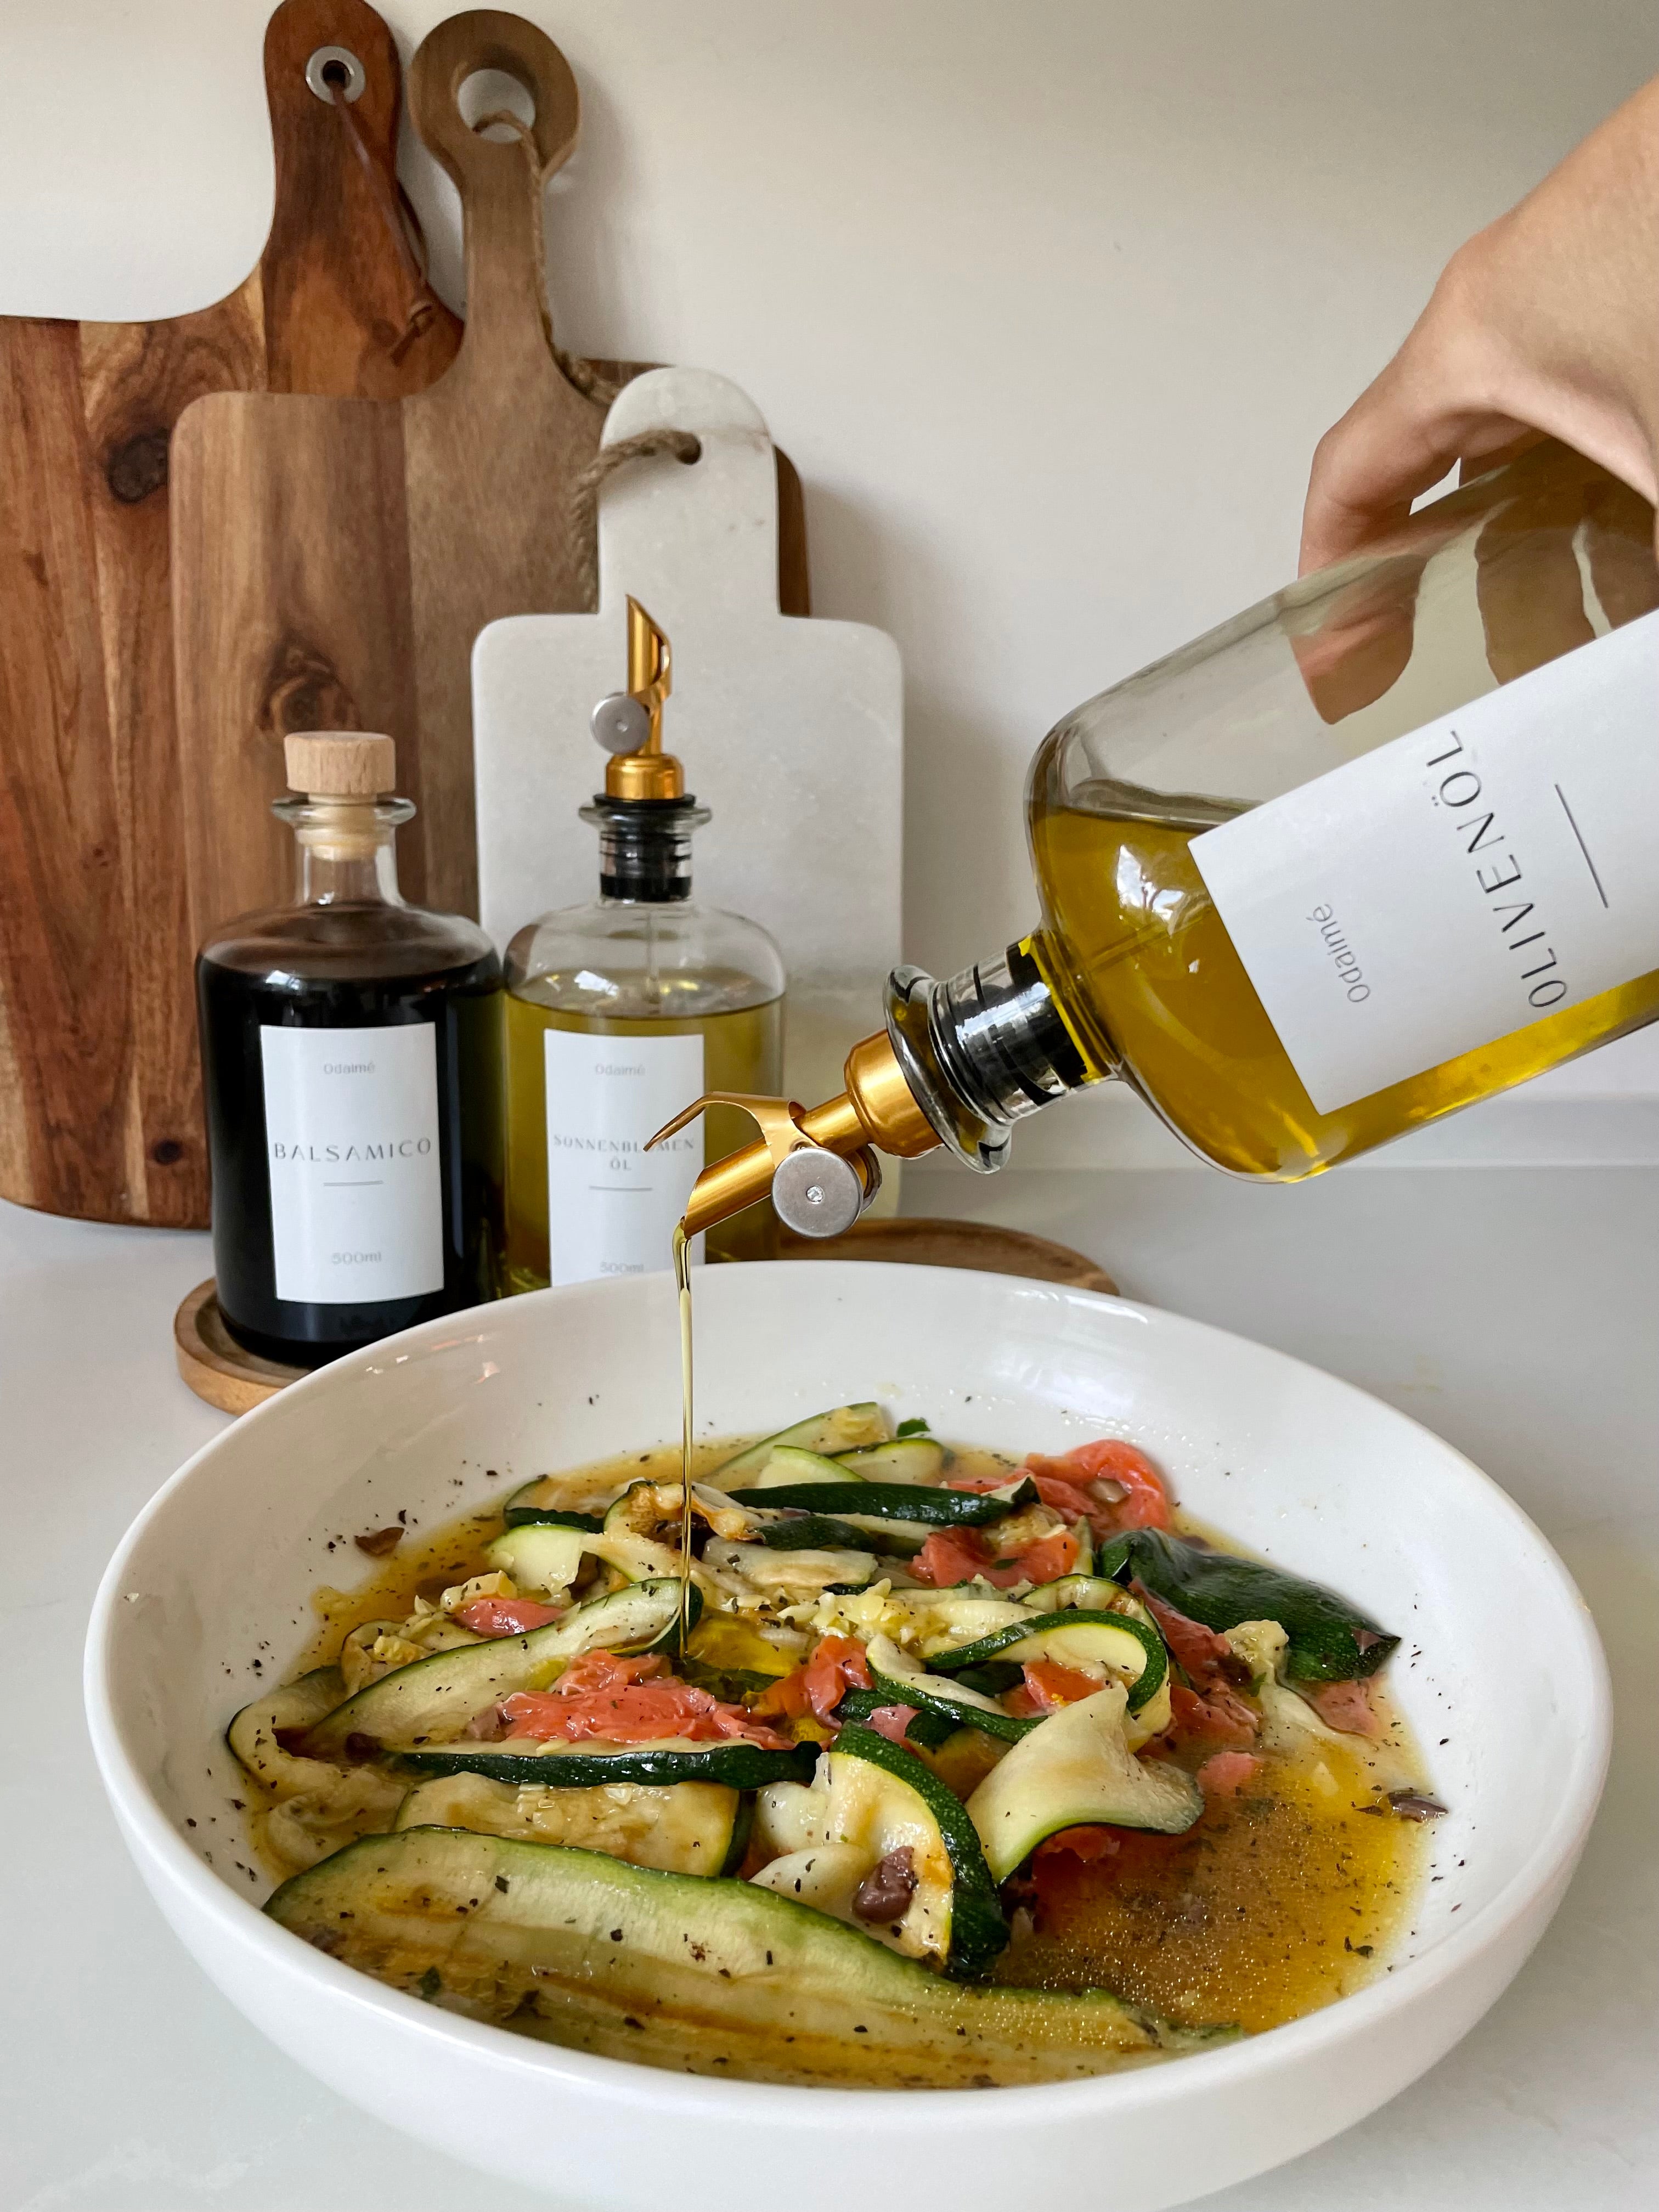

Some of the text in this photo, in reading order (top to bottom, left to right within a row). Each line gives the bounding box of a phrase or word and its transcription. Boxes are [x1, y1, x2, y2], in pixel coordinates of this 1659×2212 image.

[1427, 731, 1567, 1008] OLIVENÖL
[1306, 903, 1371, 1003] Odaimé
[274, 1138, 432, 1163] BALSAMICO
[553, 1134, 695, 1153] SONNENBLMEN
[331, 1251, 382, 1265] 500ml
